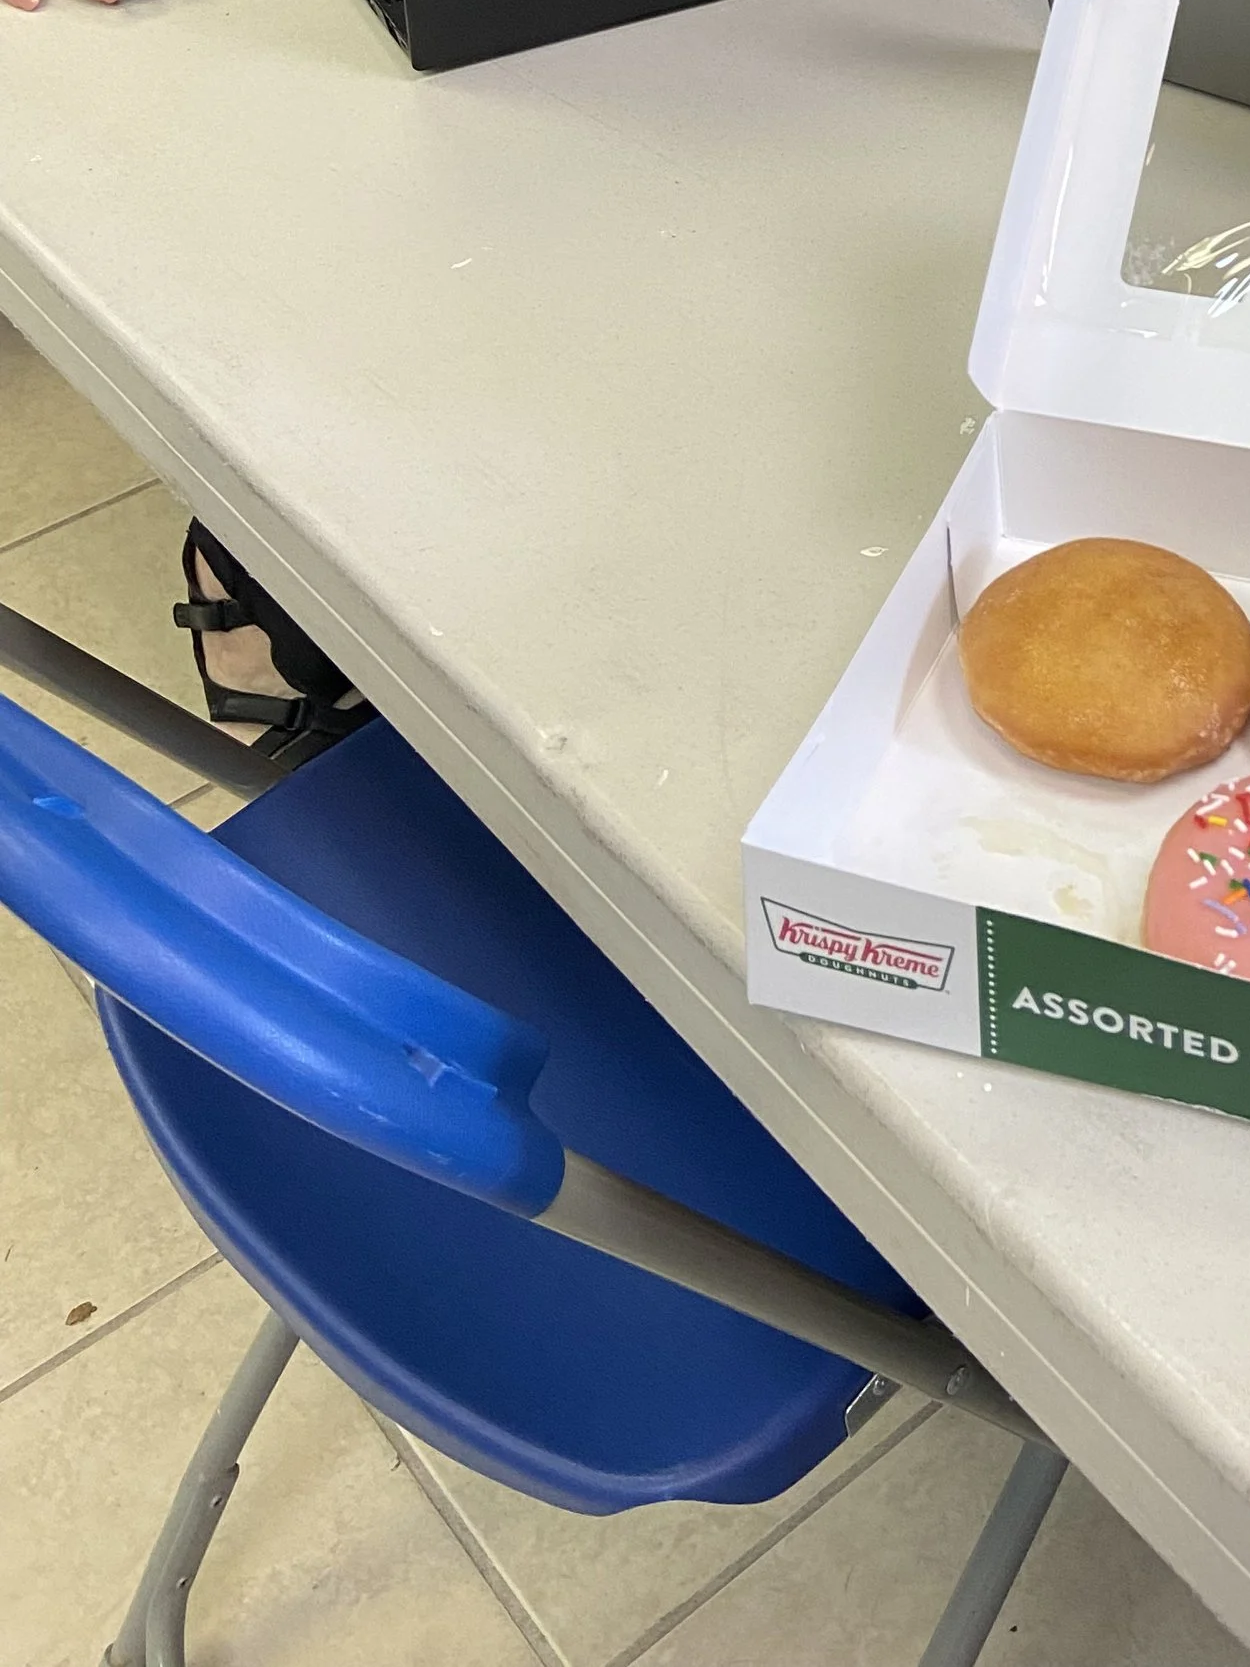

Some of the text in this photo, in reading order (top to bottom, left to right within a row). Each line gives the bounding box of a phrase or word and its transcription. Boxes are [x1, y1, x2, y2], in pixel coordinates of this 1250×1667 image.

[779, 916, 943, 979] Krispy Kreme
[808, 954, 910, 988] DOUGHNUTS
[1011, 984, 1240, 1065] ASSORTED
